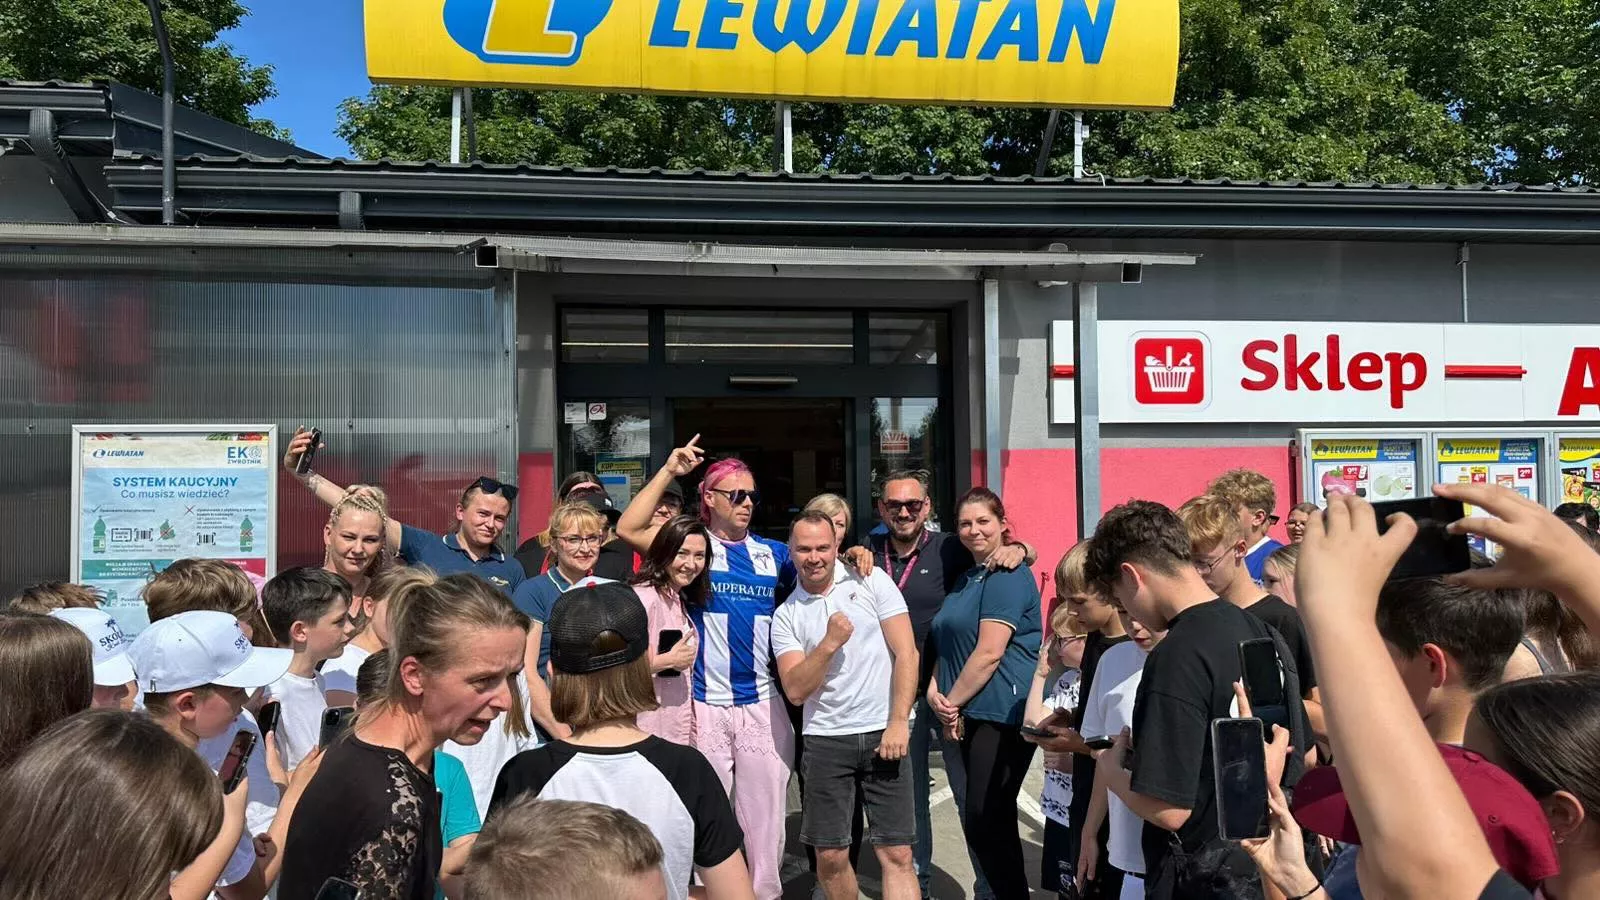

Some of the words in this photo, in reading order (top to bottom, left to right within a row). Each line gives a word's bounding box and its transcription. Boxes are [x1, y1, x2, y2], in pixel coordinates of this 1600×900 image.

[648, 0, 1116, 65] LEWIATAN
[1241, 333, 1427, 409] Sklep
[1330, 445, 1373, 454] LEWIATAN
[1455, 446, 1496, 455] LEWIATAN
[112, 477, 166, 487] SYSTEM
[169, 477, 238, 487] KAUCYJNY
[120, 489, 136, 499] Co
[138, 489, 175, 499] musisz
[177, 489, 230, 499] wiedzieć?
